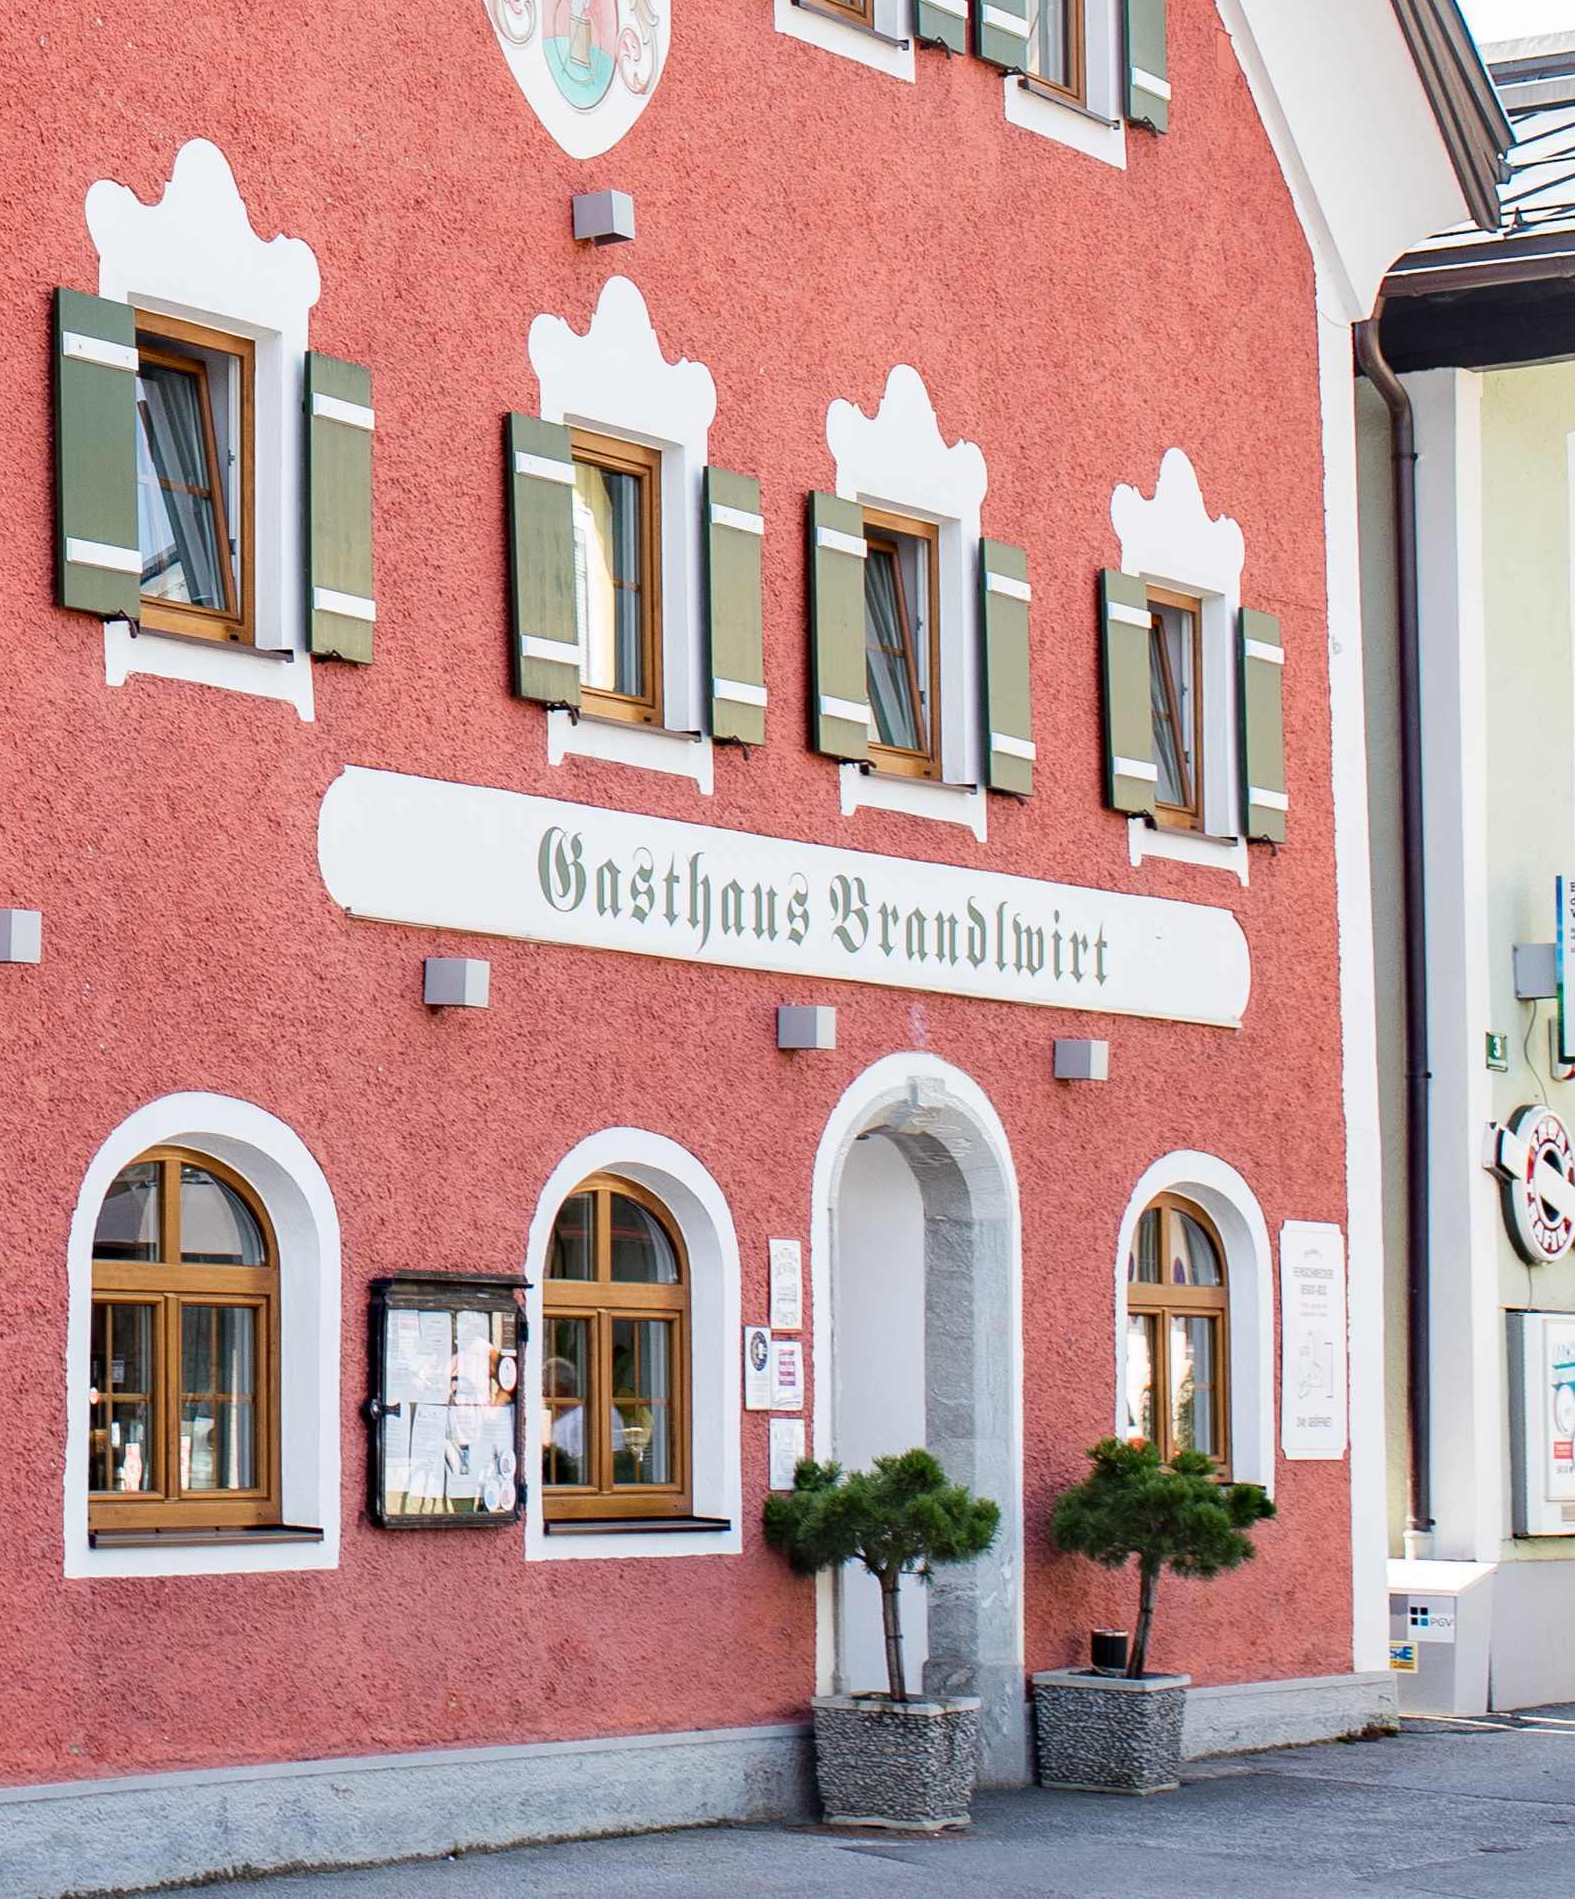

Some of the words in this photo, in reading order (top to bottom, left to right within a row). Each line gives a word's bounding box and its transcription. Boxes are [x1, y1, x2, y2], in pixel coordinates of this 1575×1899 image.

[537, 825, 811, 954] Gasthaus
[829, 873, 1108, 987] Brandlwirt
[1492, 1036, 1502, 1058] 3
